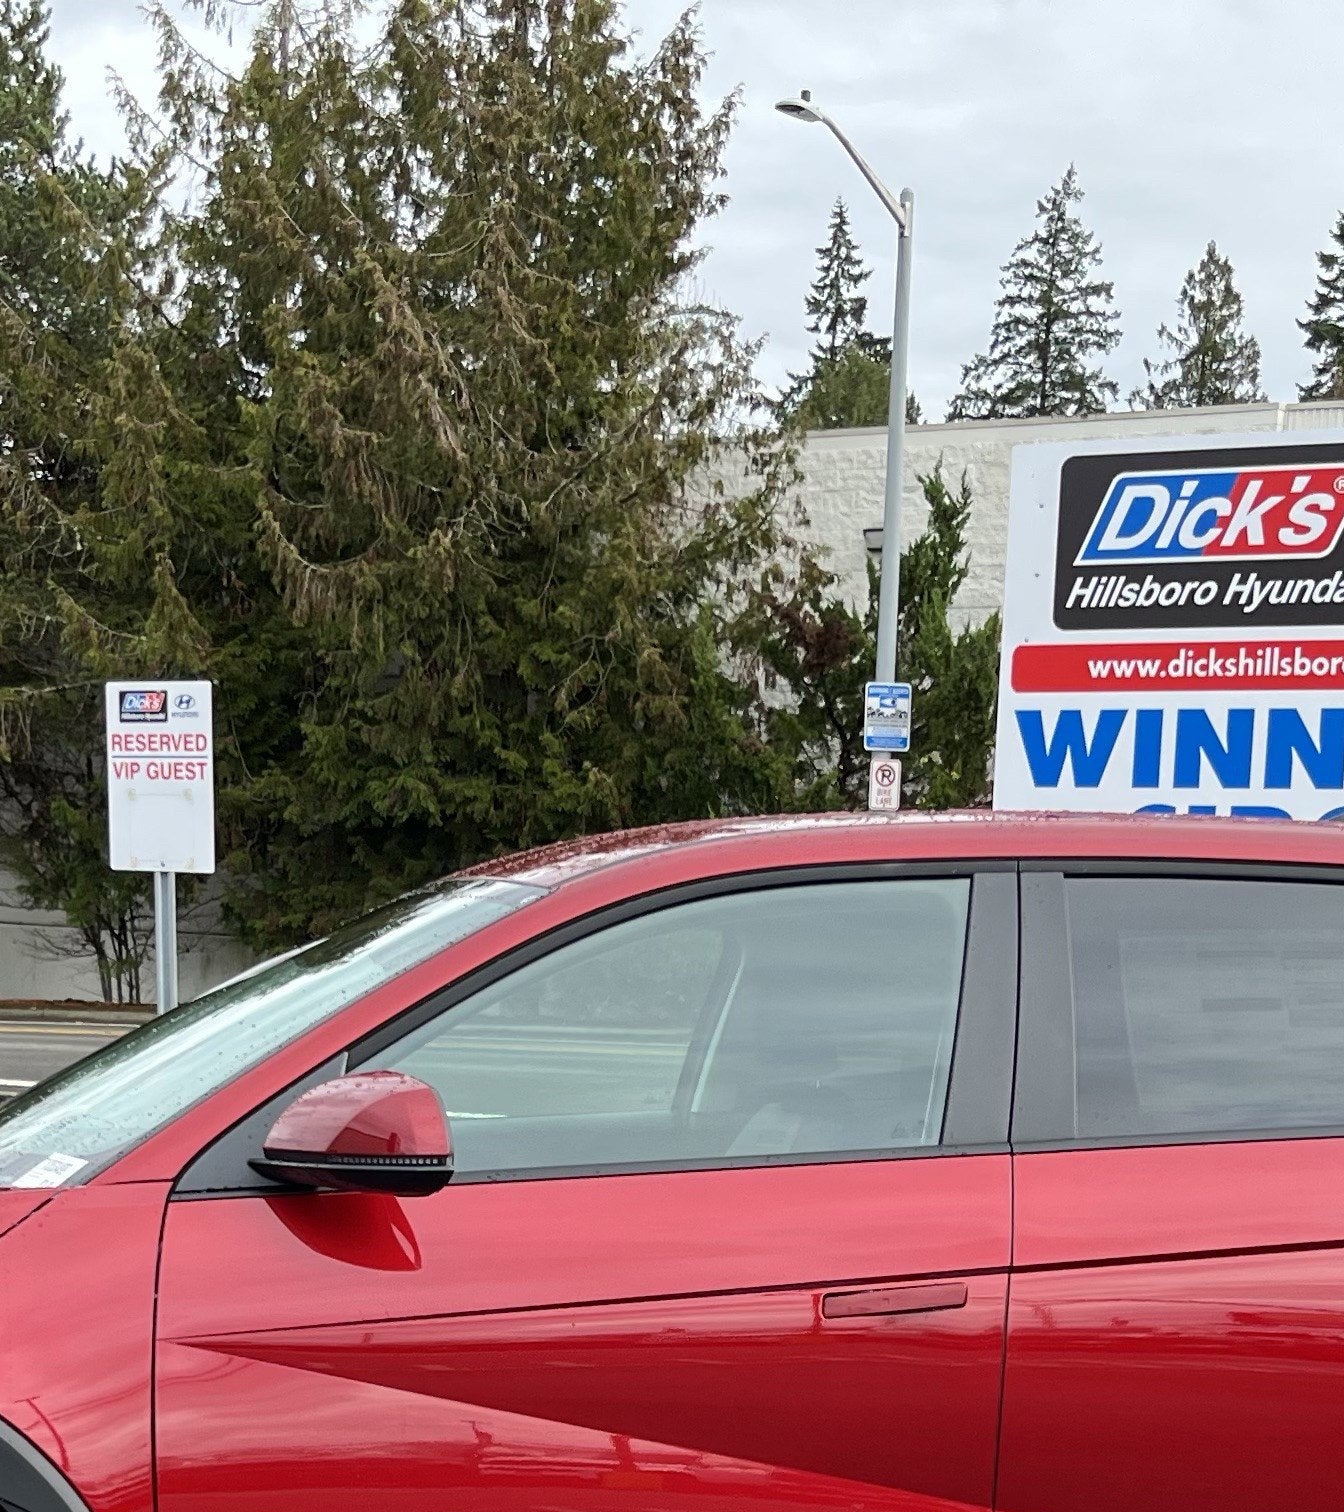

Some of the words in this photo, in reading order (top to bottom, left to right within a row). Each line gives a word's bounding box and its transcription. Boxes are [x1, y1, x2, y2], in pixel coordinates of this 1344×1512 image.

[1065, 573, 1219, 611] Hillsboro
[111, 733, 208, 752] RESERVED
[112, 761, 141, 780] VIP
[146, 761, 208, 780] GUEST
